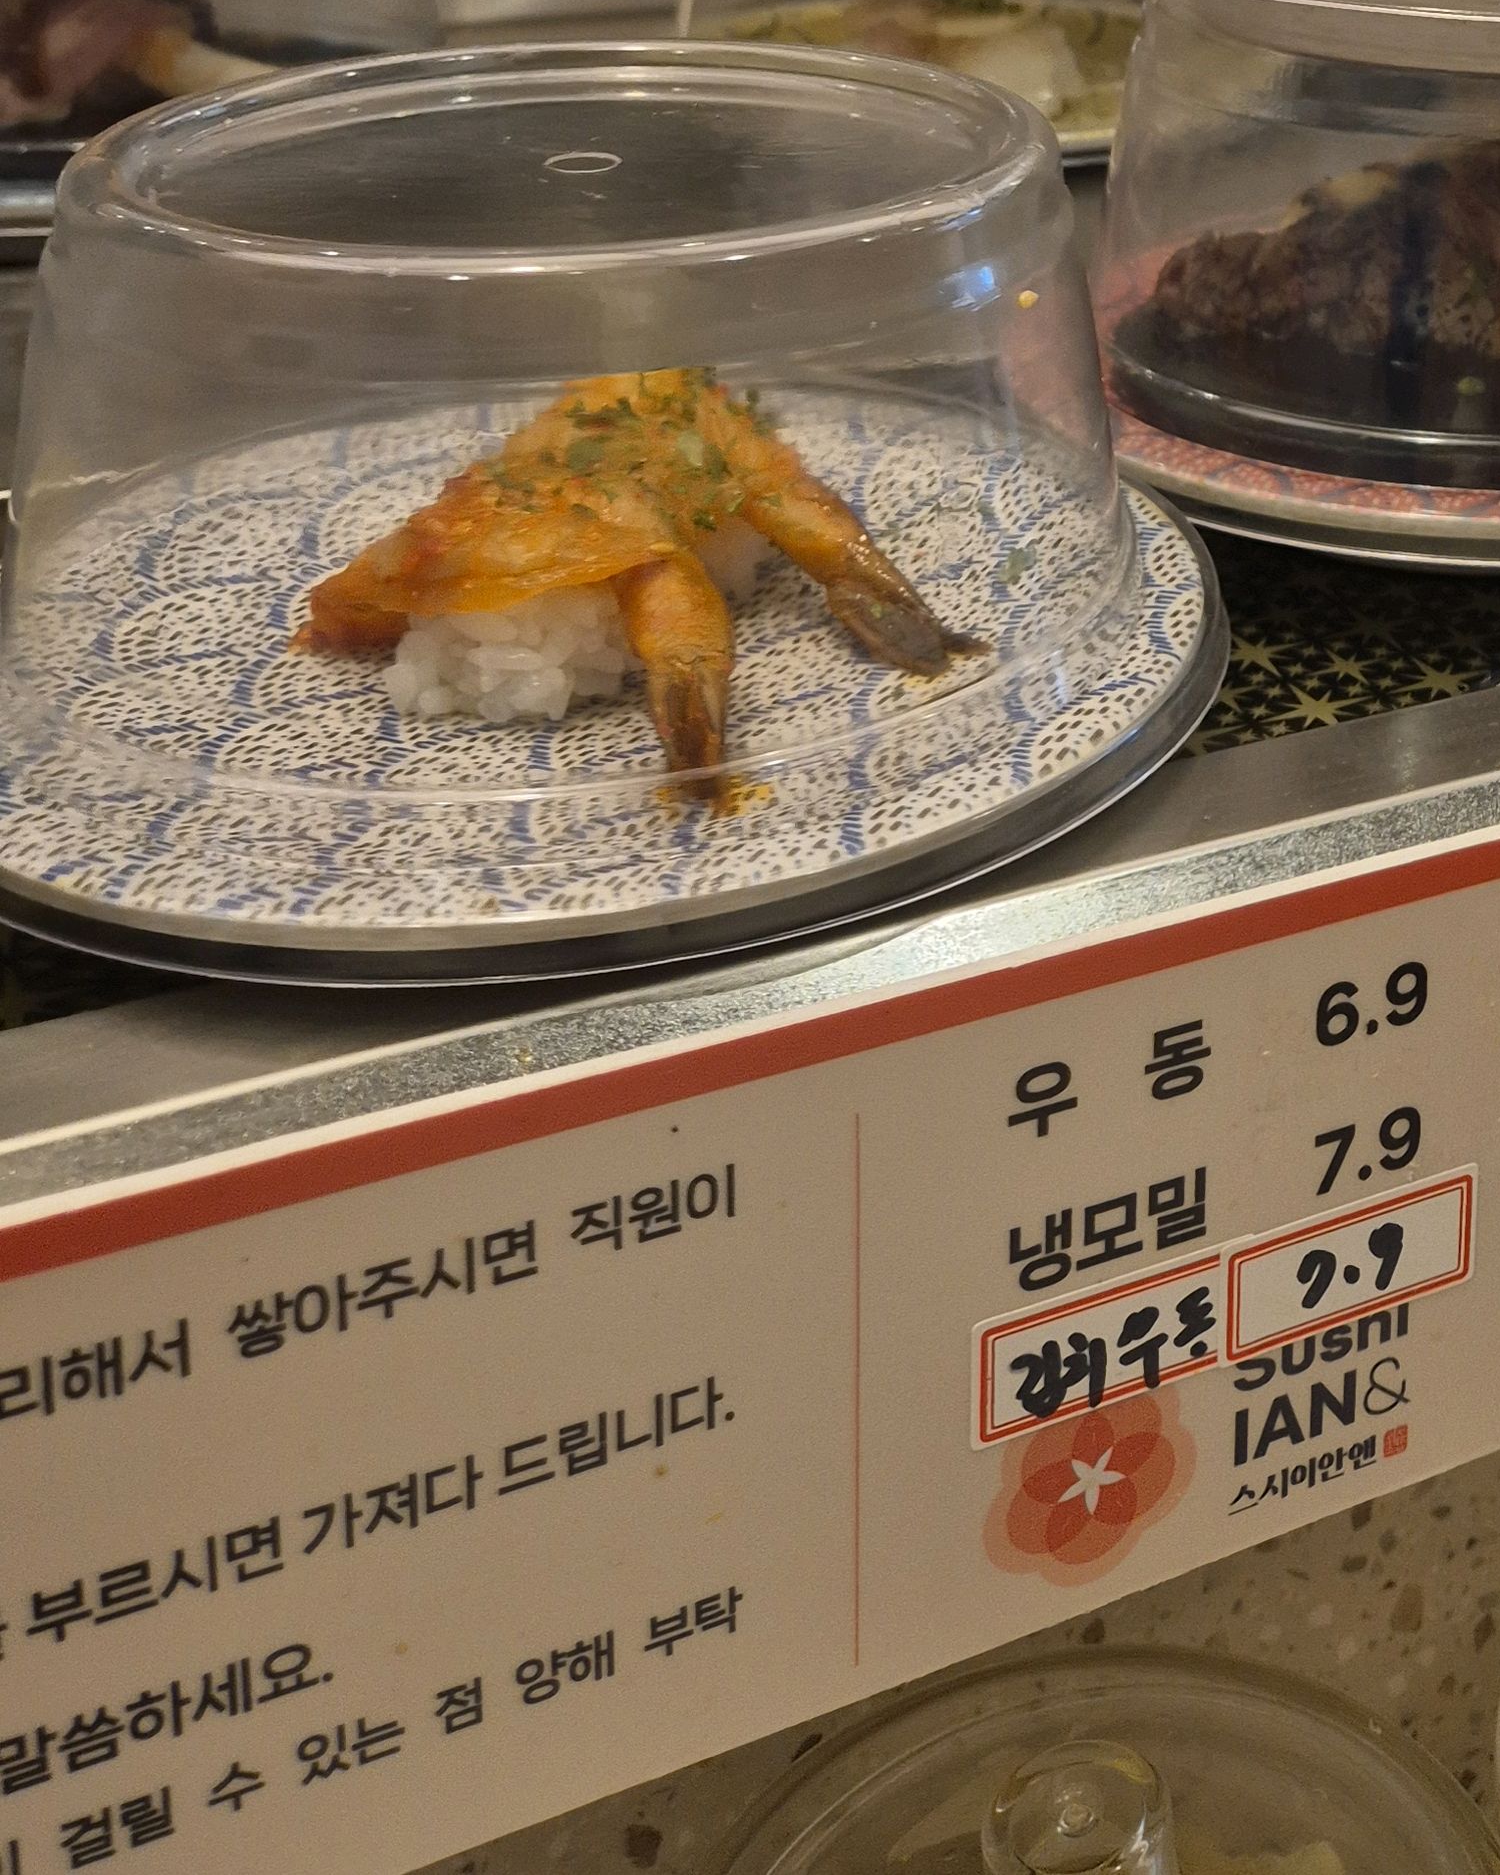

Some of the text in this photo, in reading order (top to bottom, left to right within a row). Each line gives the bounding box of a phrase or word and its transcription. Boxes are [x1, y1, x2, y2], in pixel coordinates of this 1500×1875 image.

[1316, 962, 1428, 1046] 6.9
[227, 1220, 539, 1360] 쌓아주시면
[570, 1164, 736, 1251] 직원이
[1009, 1106, 1422, 1292] 냉모밀 7.9
[26, 1376, 736, 1643] 부르시면 가져다 드립니다.
[0, 1640, 335, 1795] 말씀하세요.
[59, 1786, 175, 1870] 걸릴
[208, 1762, 265, 1812] 수
[296, 1717, 405, 1786] 있는
[434, 1677, 484, 1734] 점
[514, 1630, 616, 1705] 양해
[644, 1586, 743, 1657] 부탁
